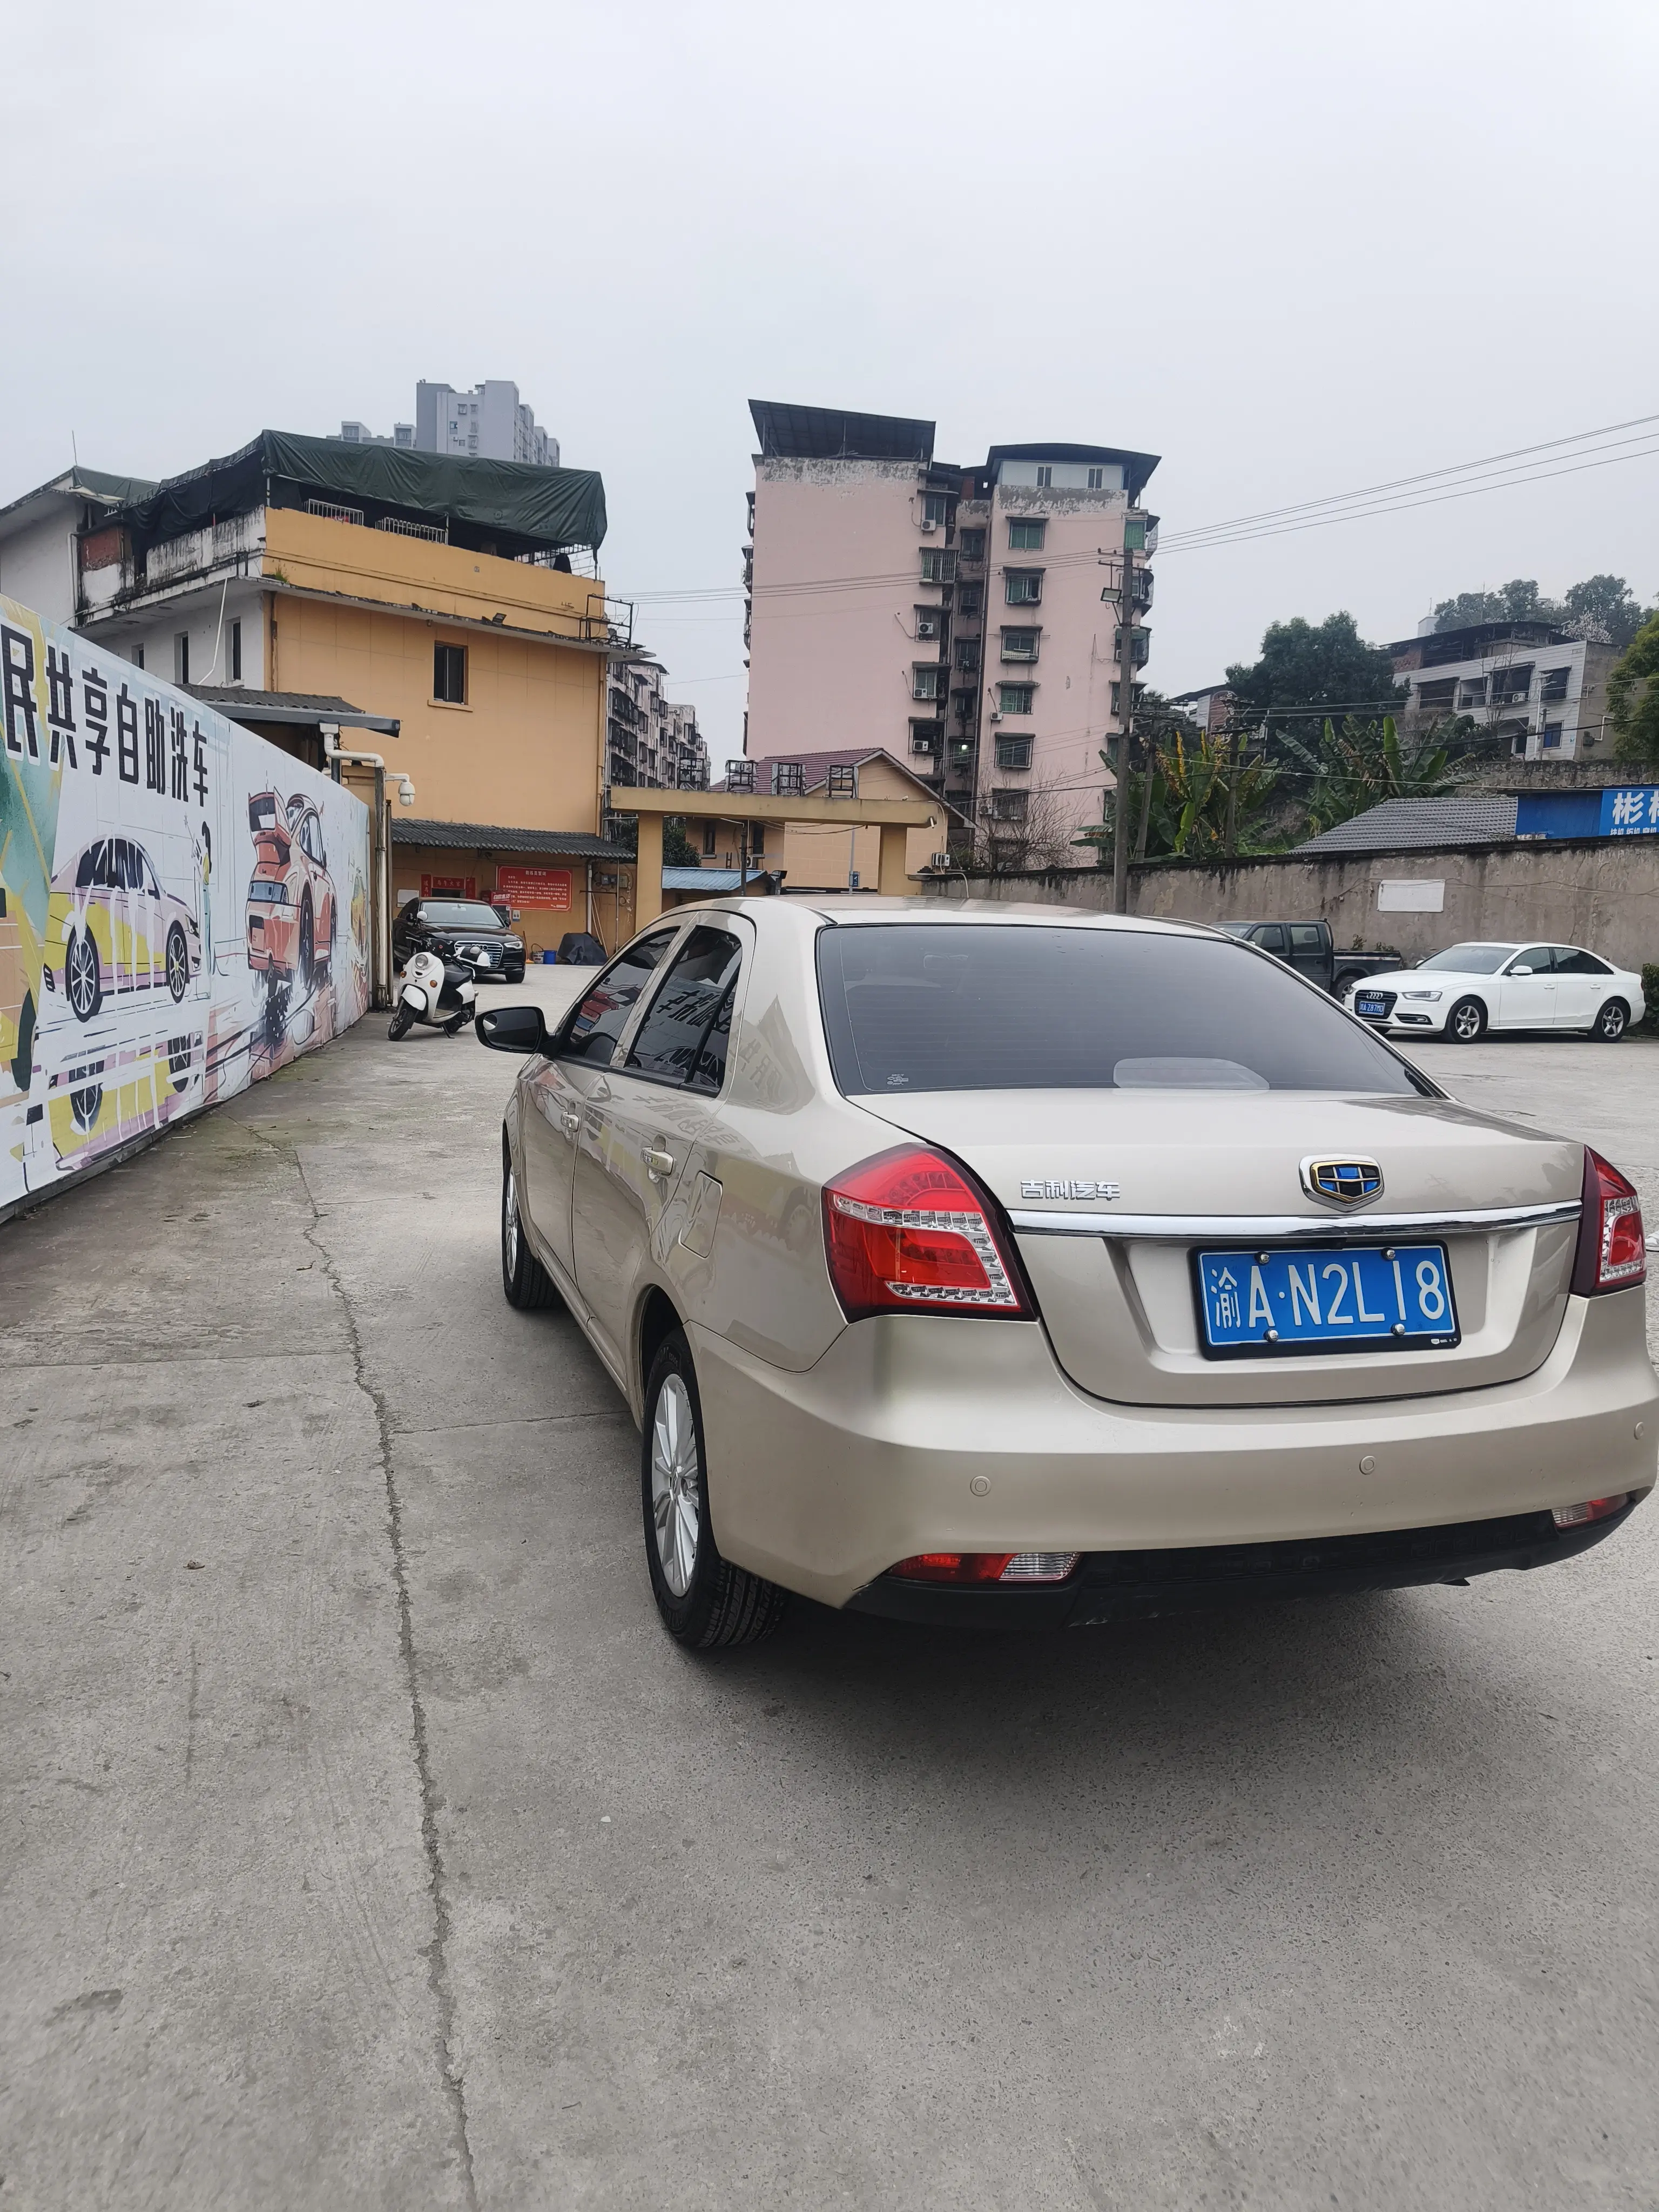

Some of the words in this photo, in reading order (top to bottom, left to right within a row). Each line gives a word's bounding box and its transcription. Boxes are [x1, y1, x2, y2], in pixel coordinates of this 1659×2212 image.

[1, 624, 209, 807] 民共享自助洗车
[1021, 1179, 1121, 1201] 吉利汽车
[1210, 1260, 1445, 1329] 渝A·N2L18
